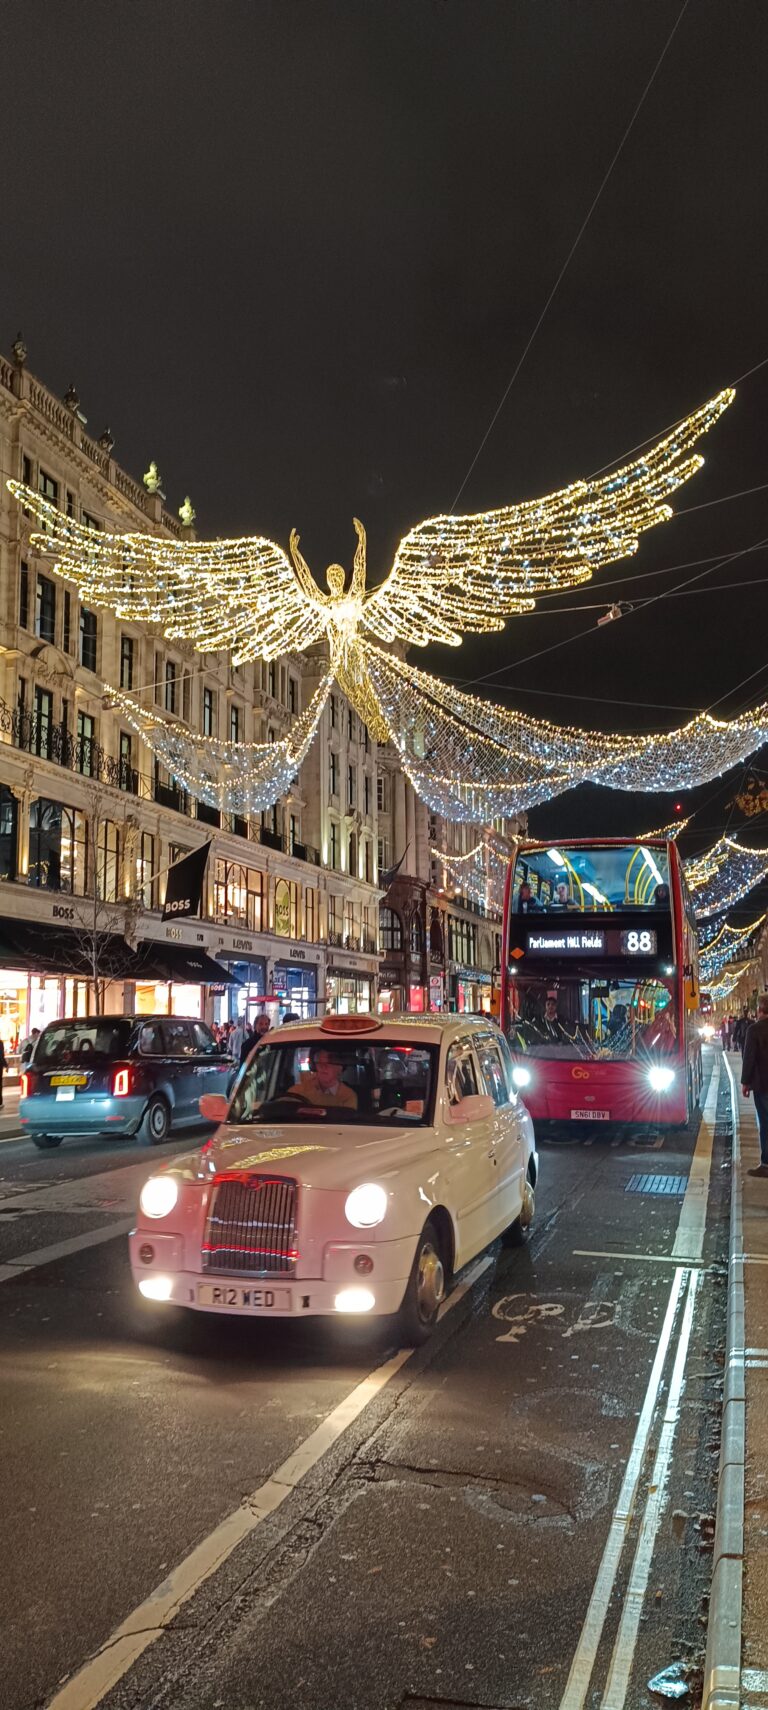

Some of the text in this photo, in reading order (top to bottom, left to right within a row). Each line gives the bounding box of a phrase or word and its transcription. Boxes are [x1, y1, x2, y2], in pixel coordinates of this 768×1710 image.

[52, 905, 75, 920] BOSS
[165, 899, 191, 913] BOSS
[275, 903, 289, 917] BOSS
[529, 936, 602, 949] Parliament Hill Fields
[626, 931, 652, 952] 88
[571, 1066, 590, 1079] Go
[212, 1287, 275, 1308] R12 WED
